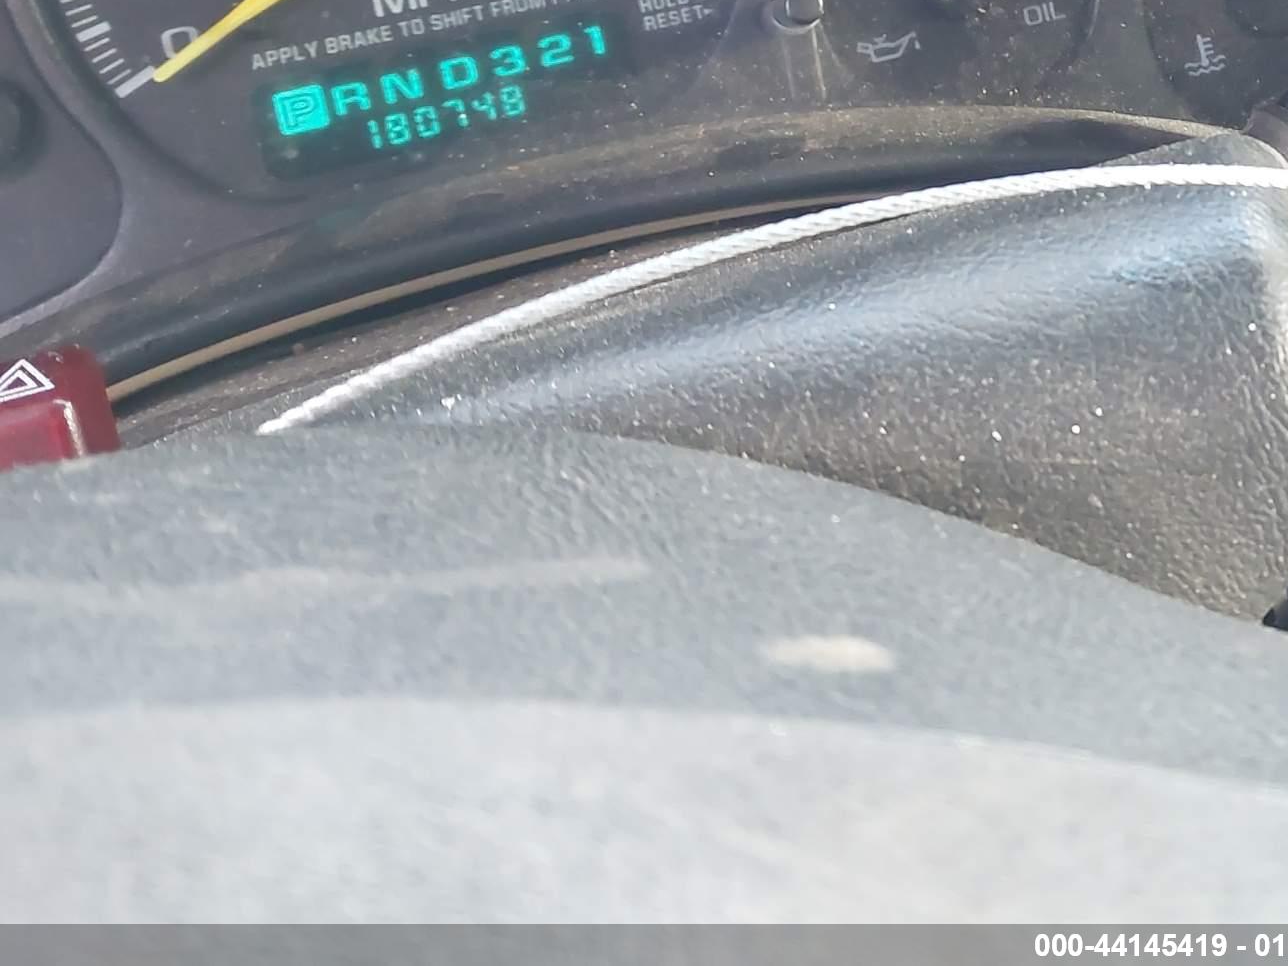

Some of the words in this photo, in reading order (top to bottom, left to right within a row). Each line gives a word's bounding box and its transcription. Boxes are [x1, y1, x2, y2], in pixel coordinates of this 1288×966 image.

[252, 41, 318, 70] APPLY
[325, 27, 393, 55] BRAKE
[397, 18, 425, 38] TO
[430, 5, 485, 32] SHIFT
[642, 6, 704, 32] RESET
[1023, 2, 1066, 26] OIL
[276, 87, 327, 132] P
[331, 82, 371, 115] R
[380, 68, 424, 105] N
[438, 56, 479, 90] D
[490, 45, 527, 79] 3
[537, 33, 575, 67] 2
[584, 25, 606, 55] 1
[367, 85, 526, 148] 180748
